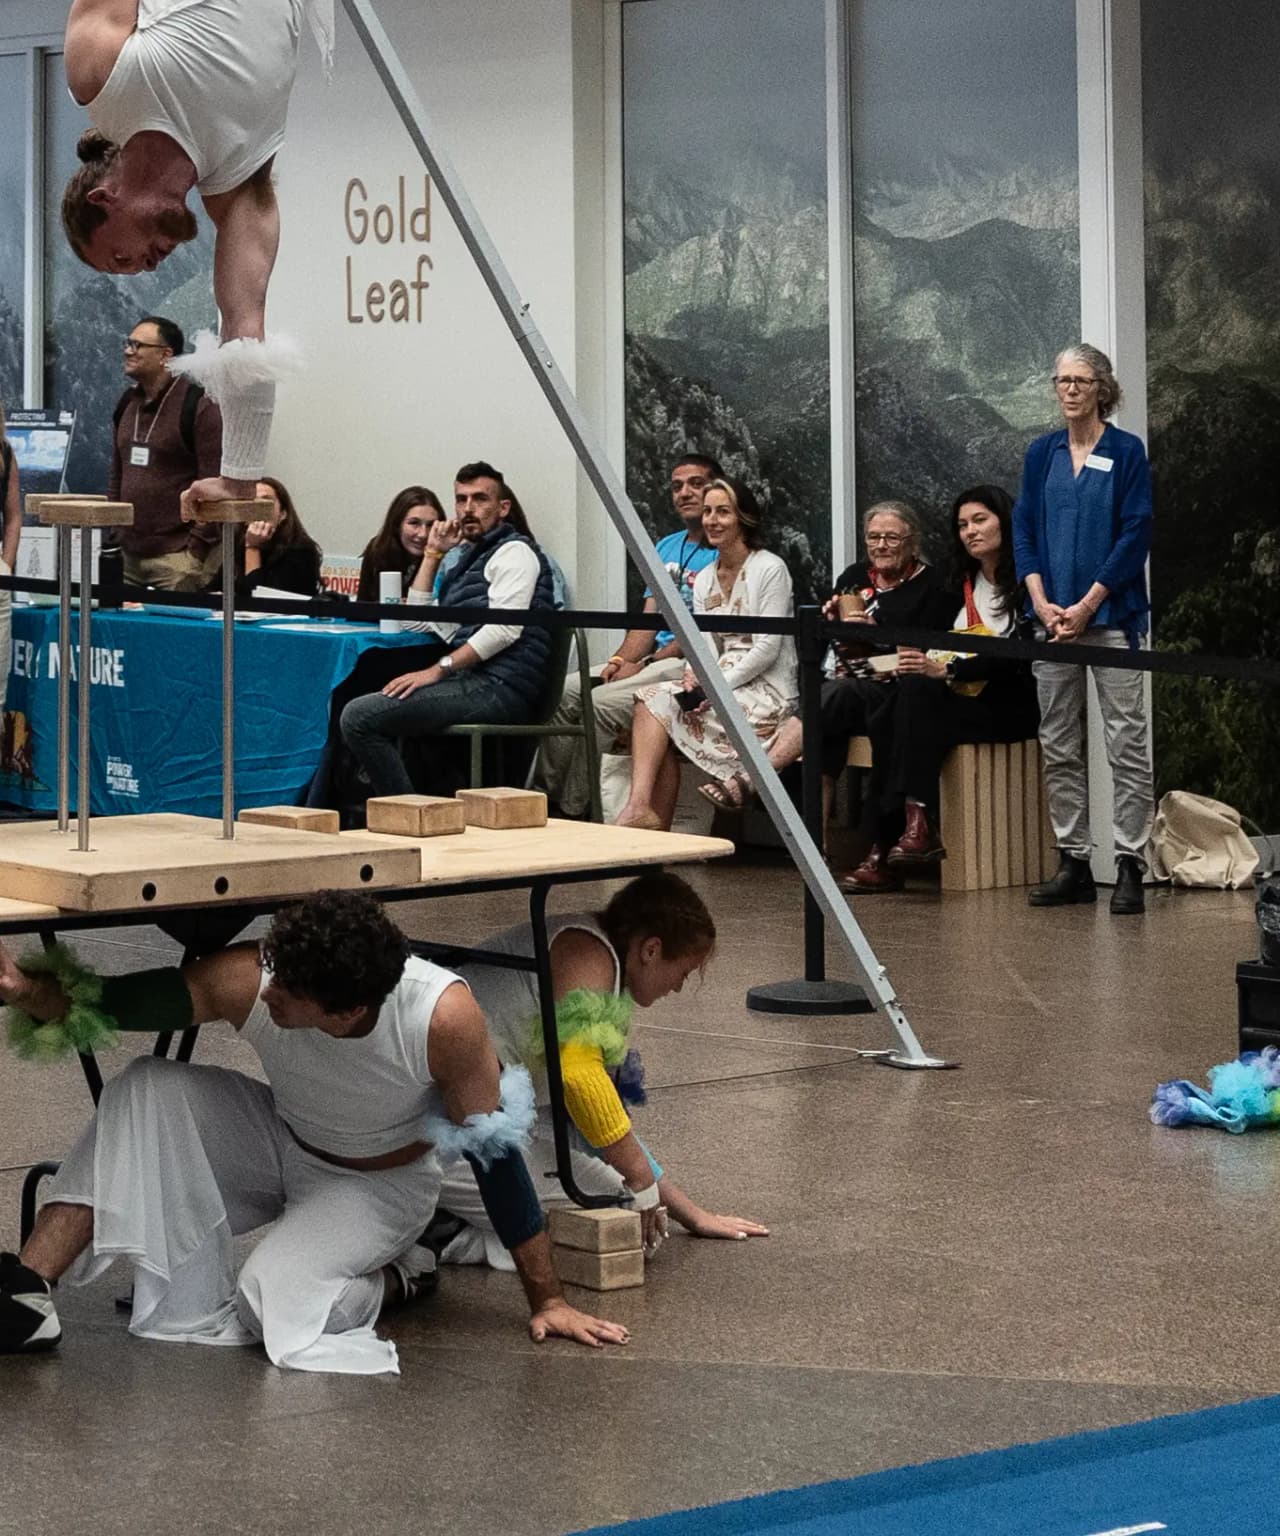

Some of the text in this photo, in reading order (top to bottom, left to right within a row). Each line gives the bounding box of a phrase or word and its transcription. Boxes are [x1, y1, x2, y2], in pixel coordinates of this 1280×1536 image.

[344, 174, 431, 245] Gold
[346, 254, 433, 324] Leaf
[321, 576, 360, 595] POWE
[48, 642, 125, 687] NAURE
